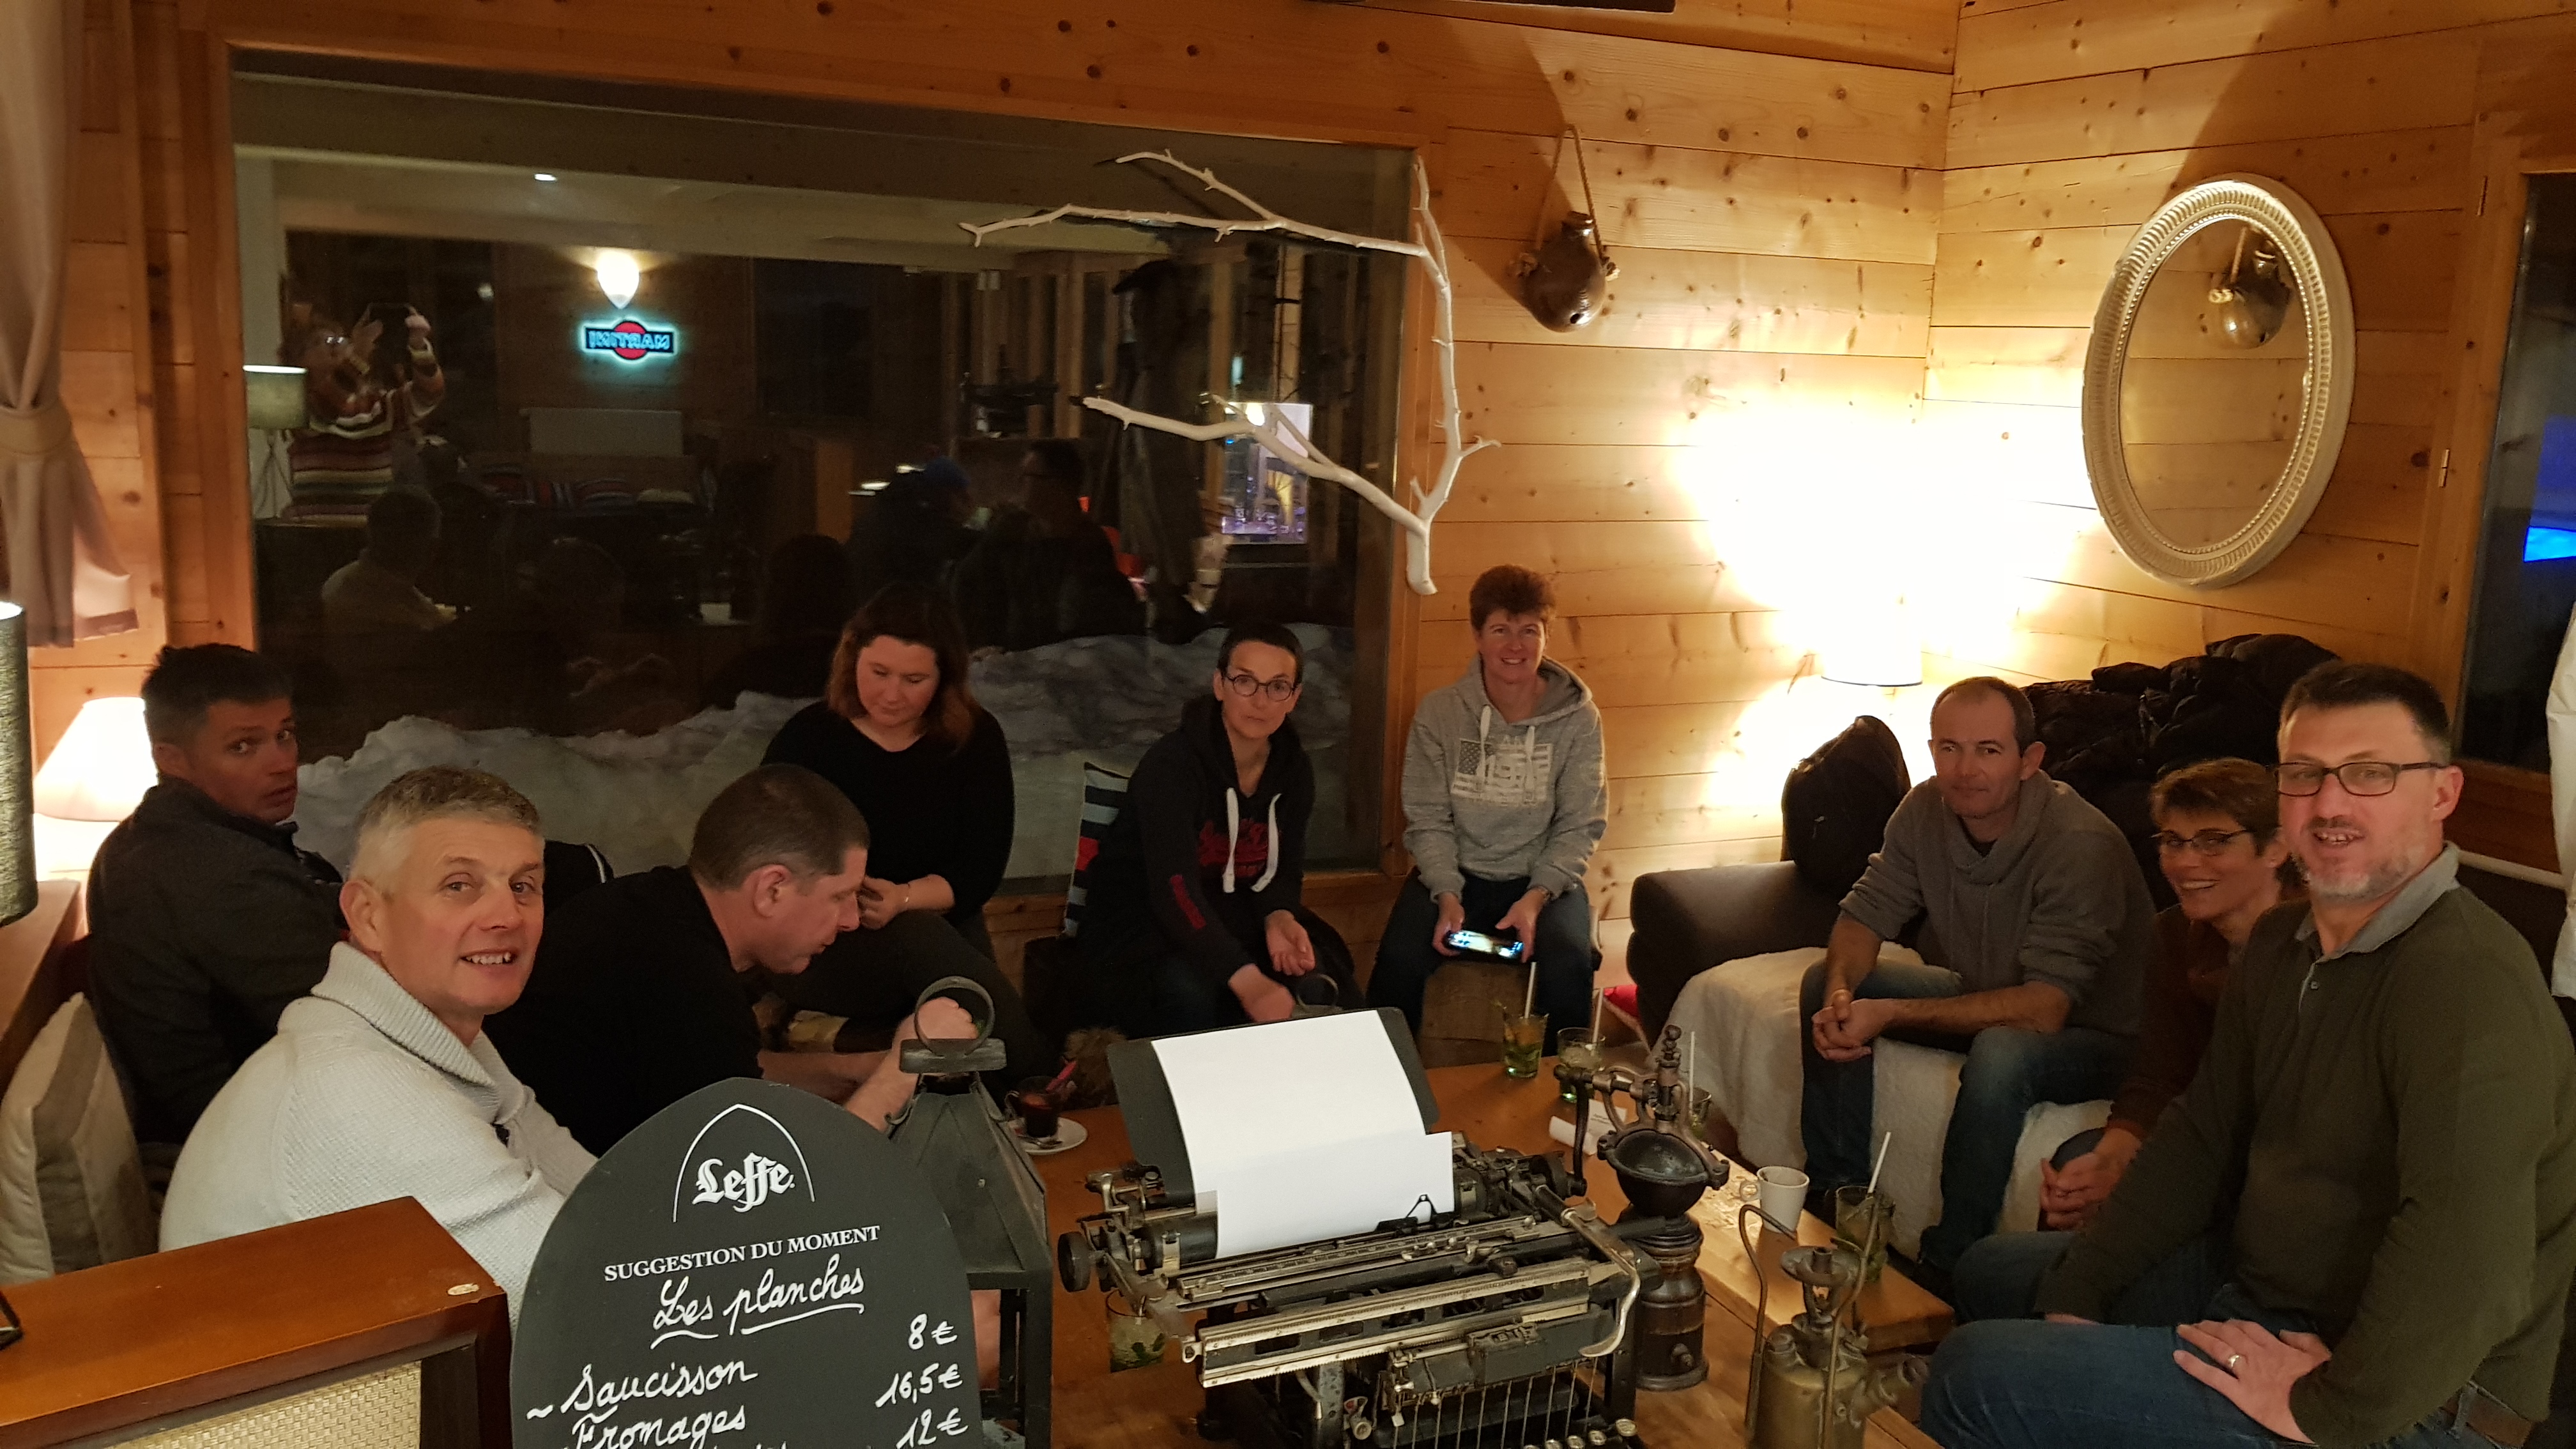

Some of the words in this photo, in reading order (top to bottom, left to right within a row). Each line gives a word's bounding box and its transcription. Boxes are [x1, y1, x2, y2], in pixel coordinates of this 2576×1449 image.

[604, 1245, 746, 1282] SUGGESTION
[751, 1240, 783, 1260] DU
[787, 1225, 880, 1255] MOMENT
[652, 1276, 714, 1331] Les
[723, 1253, 865, 1336] planches
[560, 1363, 759, 1414] Saucisson
[571, 1405, 746, 1449] Fromages
[875, 1362, 963, 1409] 16,5€
